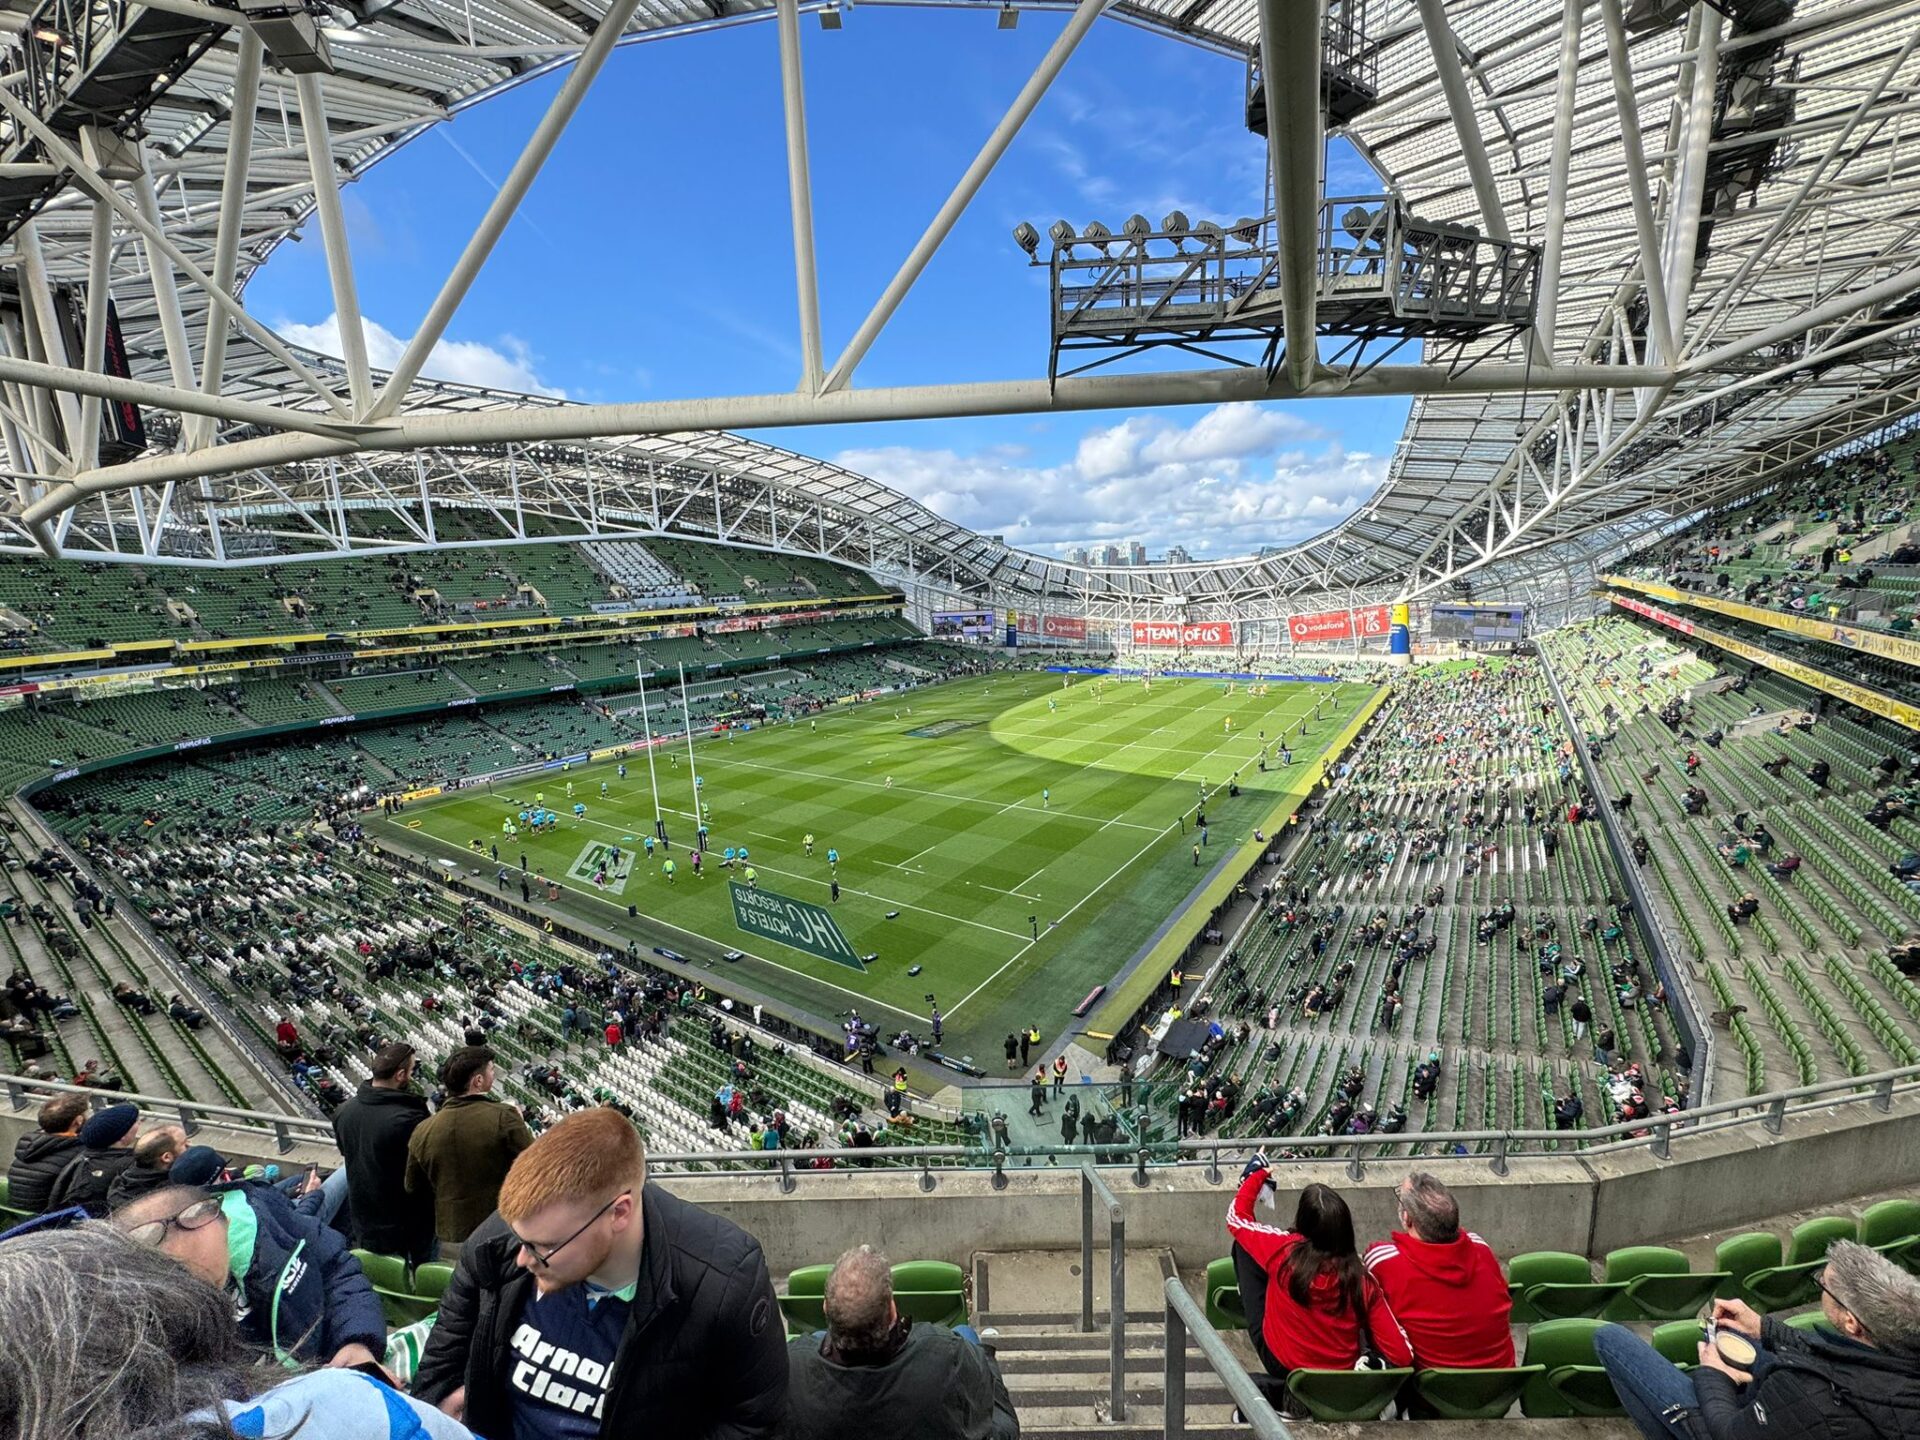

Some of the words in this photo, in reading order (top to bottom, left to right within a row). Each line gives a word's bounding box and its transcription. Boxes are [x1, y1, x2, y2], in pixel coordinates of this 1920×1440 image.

[1308, 622, 1345, 632] vodafone
[207, 663, 235, 671] AVIVA
[255, 659, 282, 667] AVIVA
[66, 678, 96, 687] AVIVA
[735, 888, 784, 914] RESORTS
[748, 908, 794, 938] HOTELS
